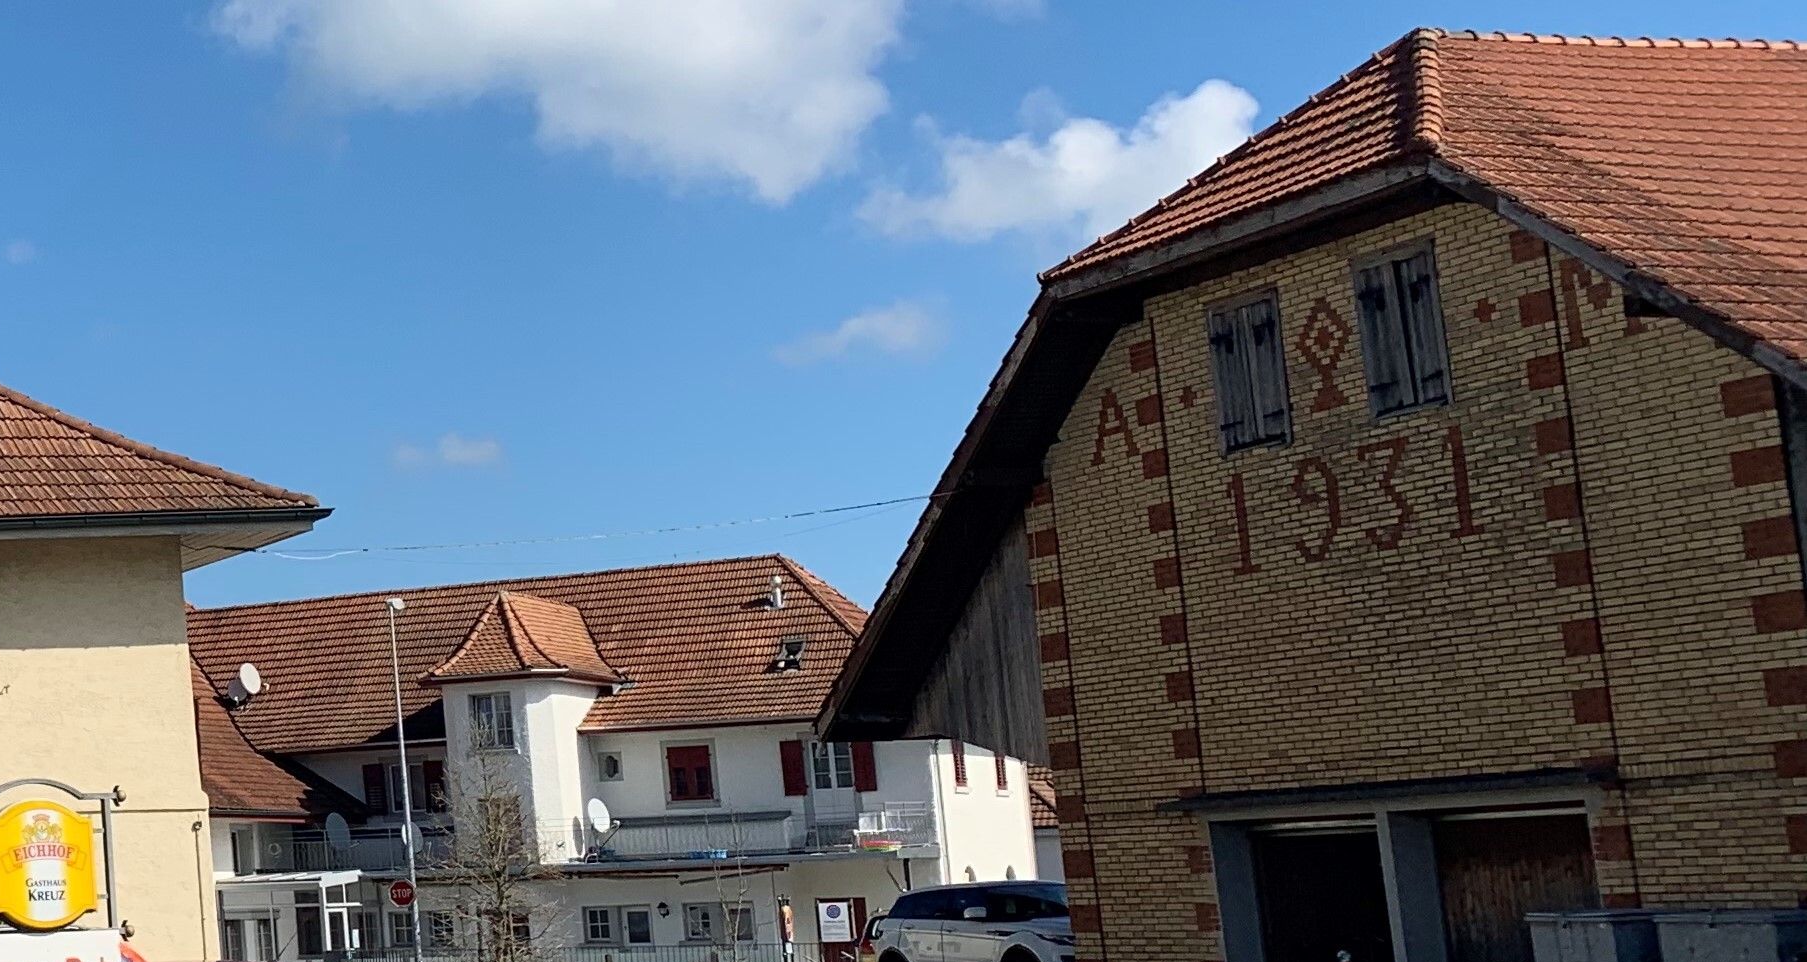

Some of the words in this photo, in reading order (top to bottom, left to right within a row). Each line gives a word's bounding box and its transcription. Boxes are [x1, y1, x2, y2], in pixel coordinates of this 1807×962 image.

[1227, 424, 1485, 574] 1931
[13, 844, 75, 861] EICHHOF
[392, 888, 412, 899] STOP
